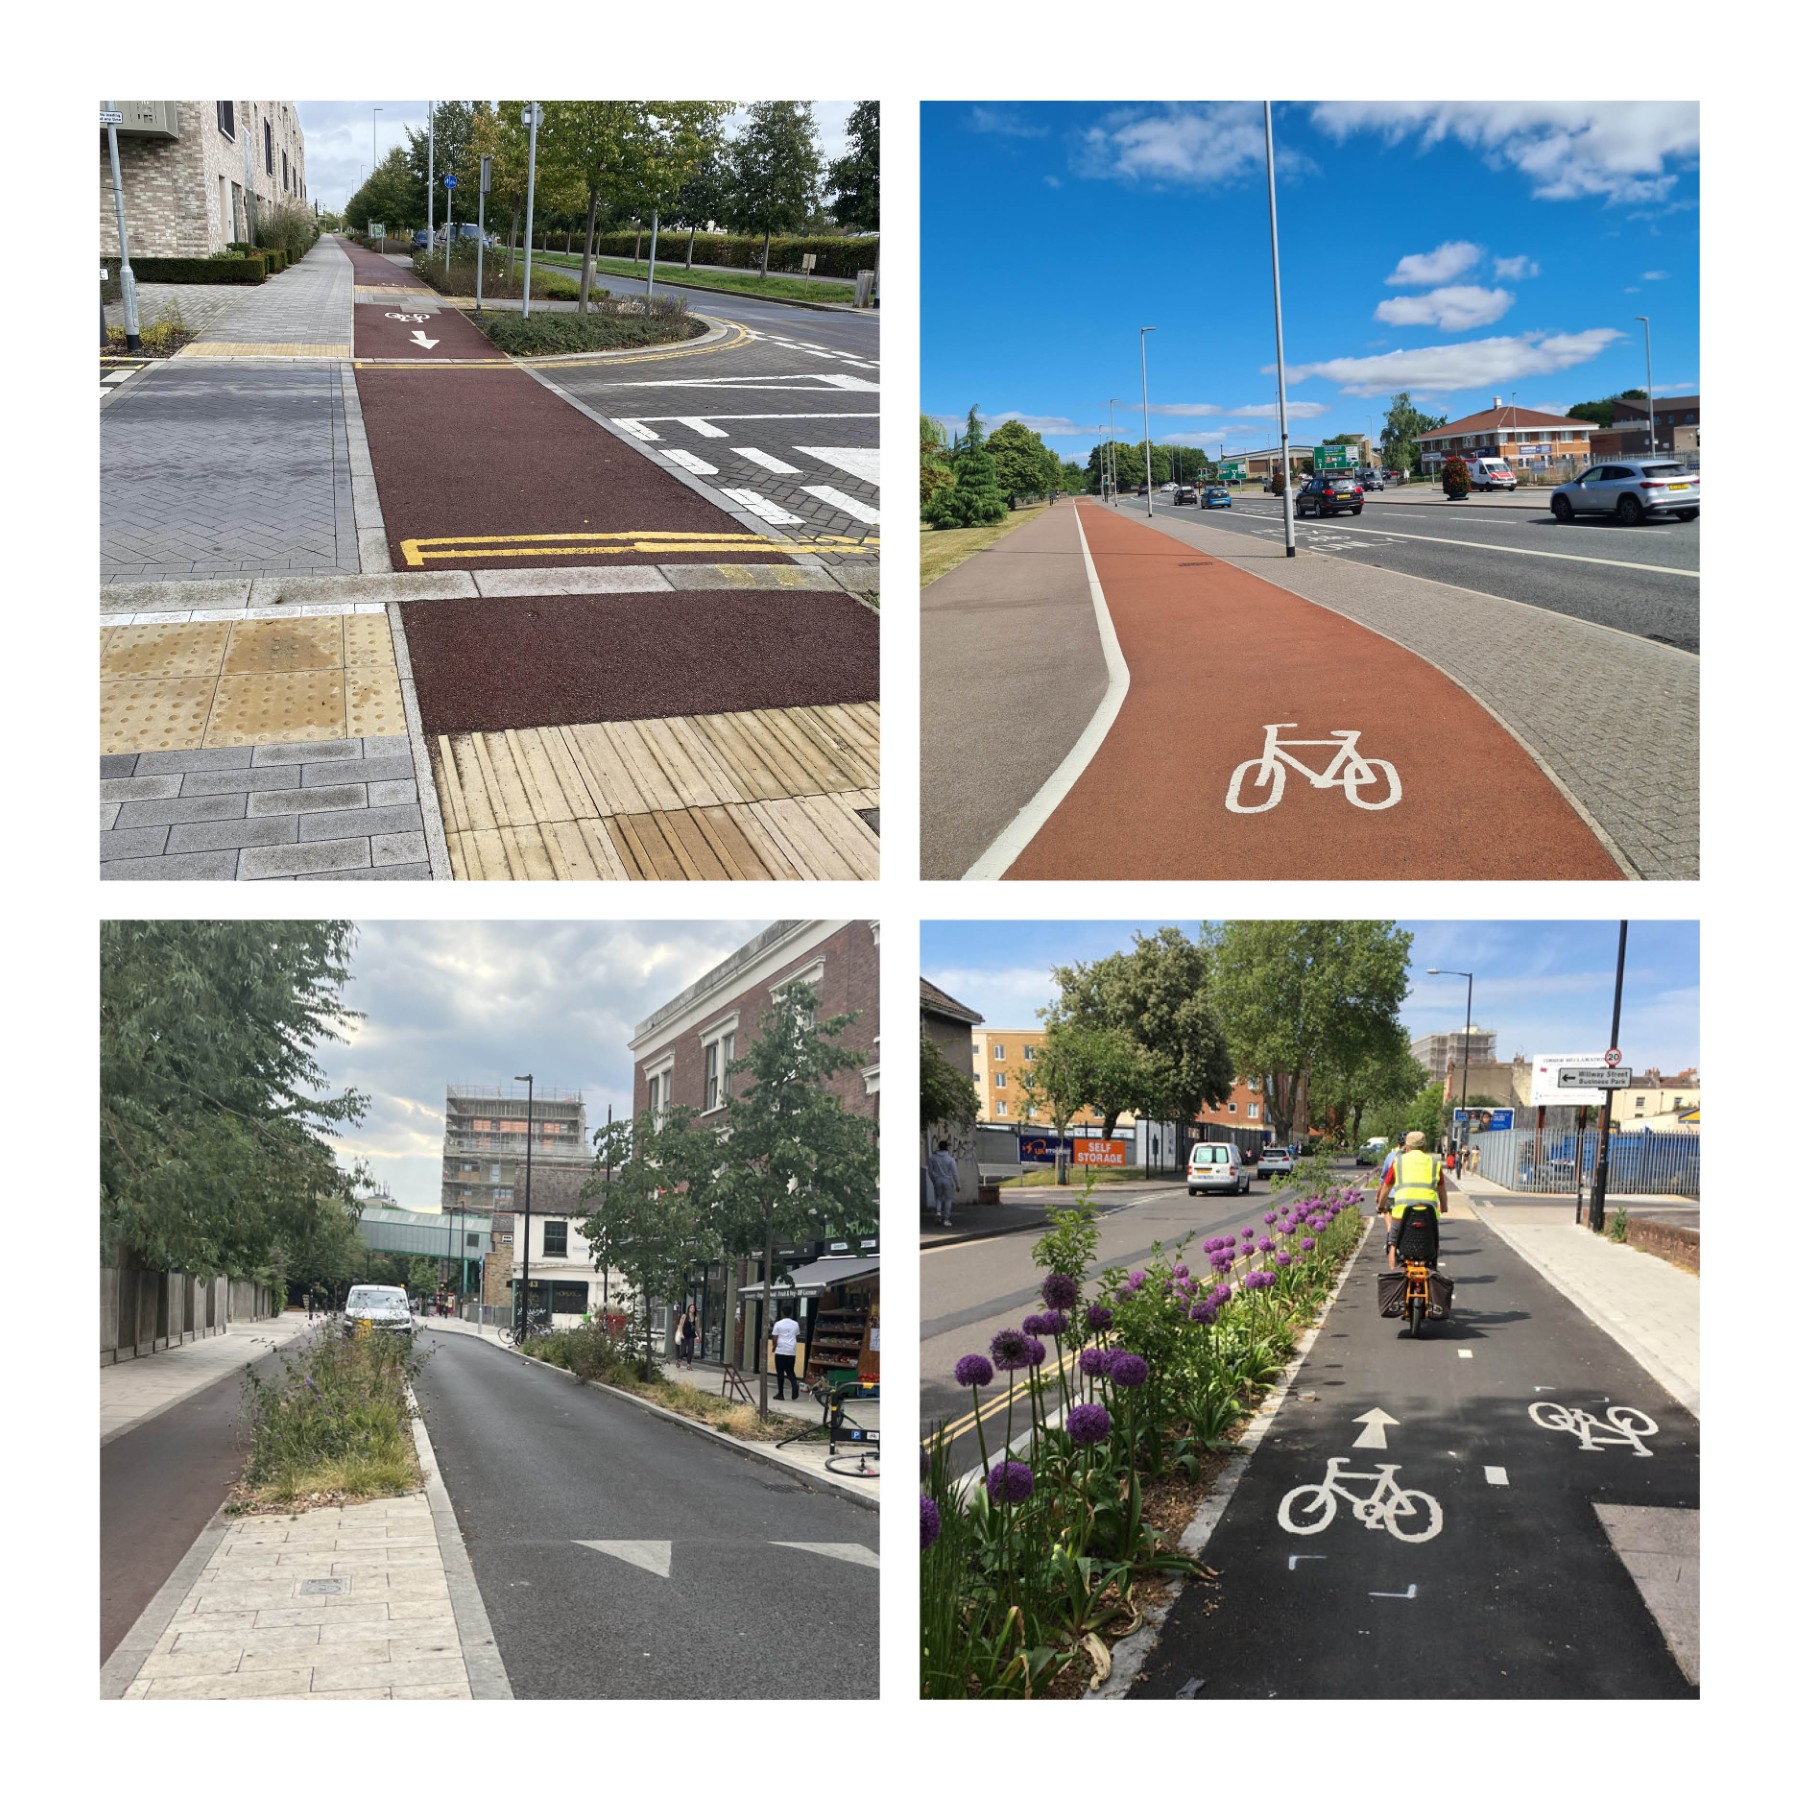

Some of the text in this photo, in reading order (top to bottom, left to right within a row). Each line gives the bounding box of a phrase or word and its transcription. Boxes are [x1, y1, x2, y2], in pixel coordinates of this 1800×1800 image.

[1608, 1053, 1620, 1061] 20
[1088, 1142, 1112, 1152] SELF
[1077, 1152, 1123, 1164] STORAGE
